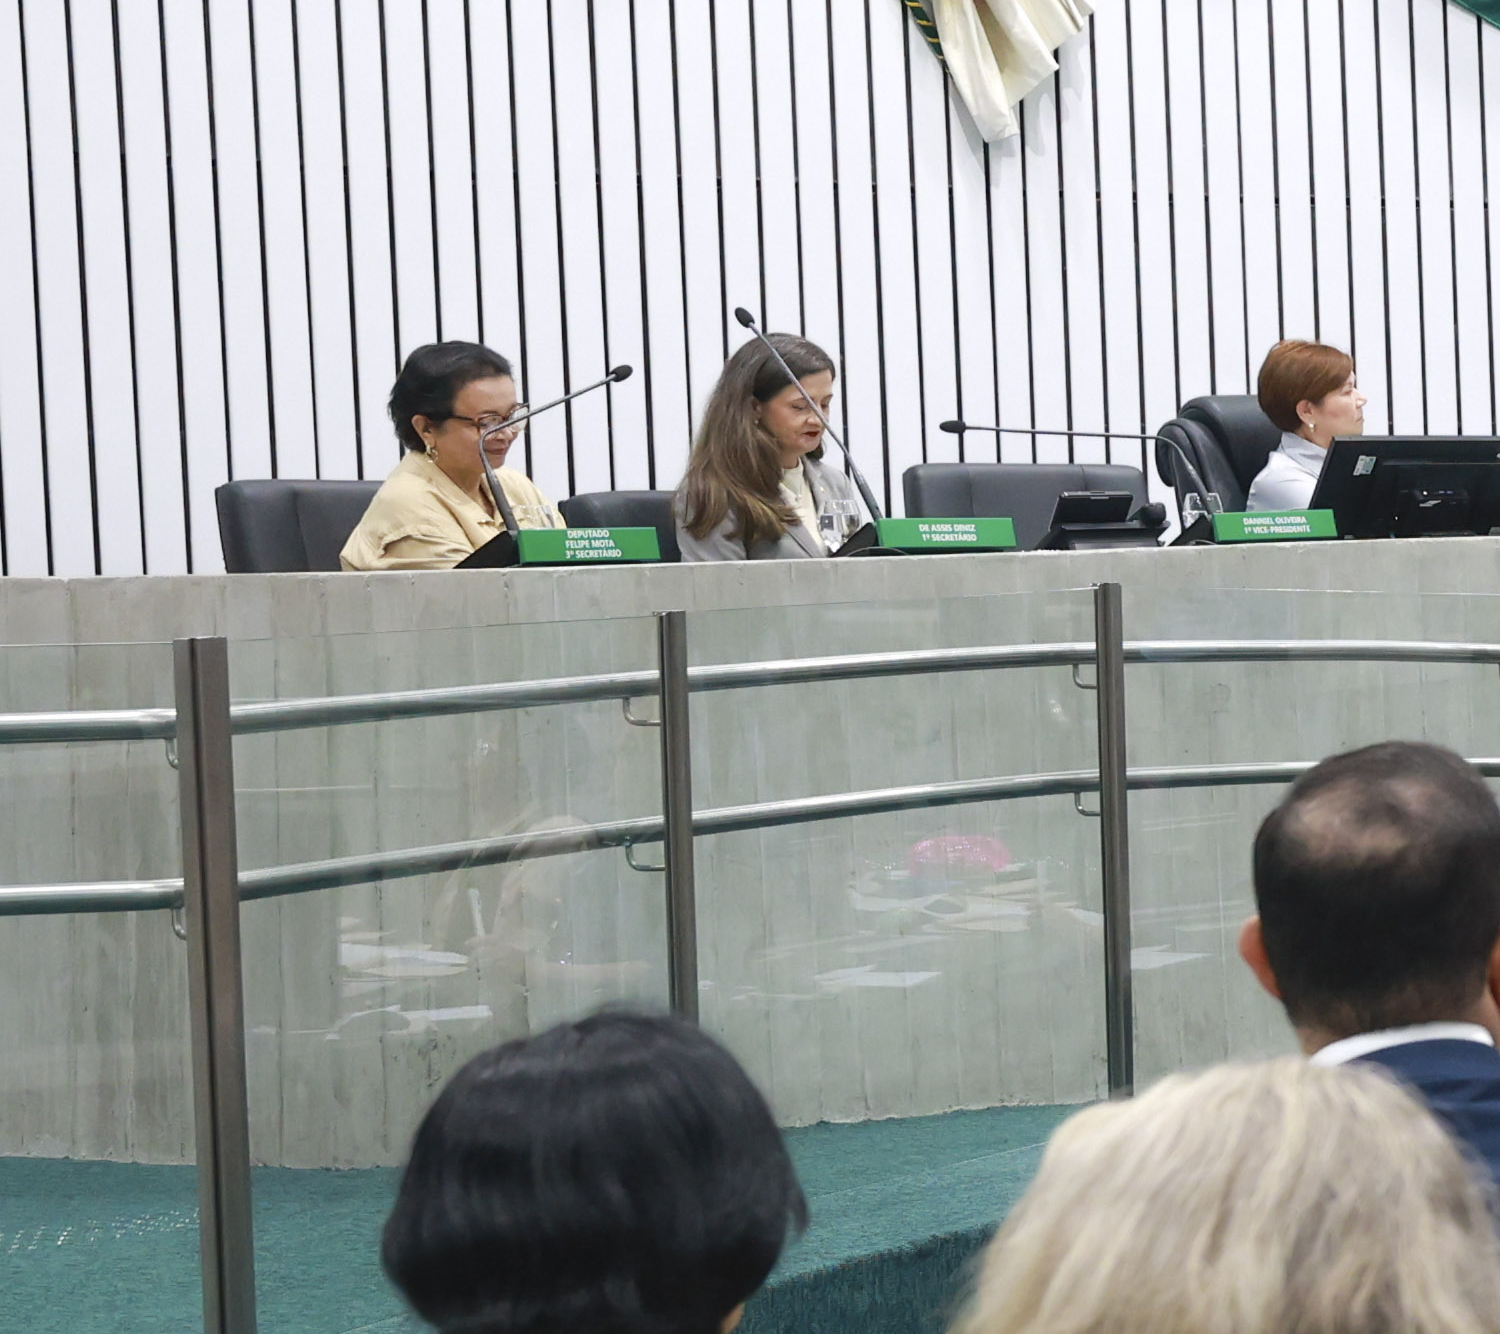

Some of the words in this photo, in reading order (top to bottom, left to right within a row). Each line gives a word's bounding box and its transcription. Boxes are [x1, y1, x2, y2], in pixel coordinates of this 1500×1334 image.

[1275, 516, 1307, 524] OLIVEIRA
[919, 524, 929, 532] DE
[931, 524, 953, 532] ASSIS
[953, 524, 976, 532] DINIZ
[1253, 525, 1311, 534] VICE-PRESIDENTE
[567, 530, 609, 538] DEPUTADO
[931, 532, 977, 541] SECRETÁRIO
[565, 540, 590, 549] FELIPE
[591, 539, 615, 548] MOTA
[575, 548, 622, 559] SECRETÁRIO
